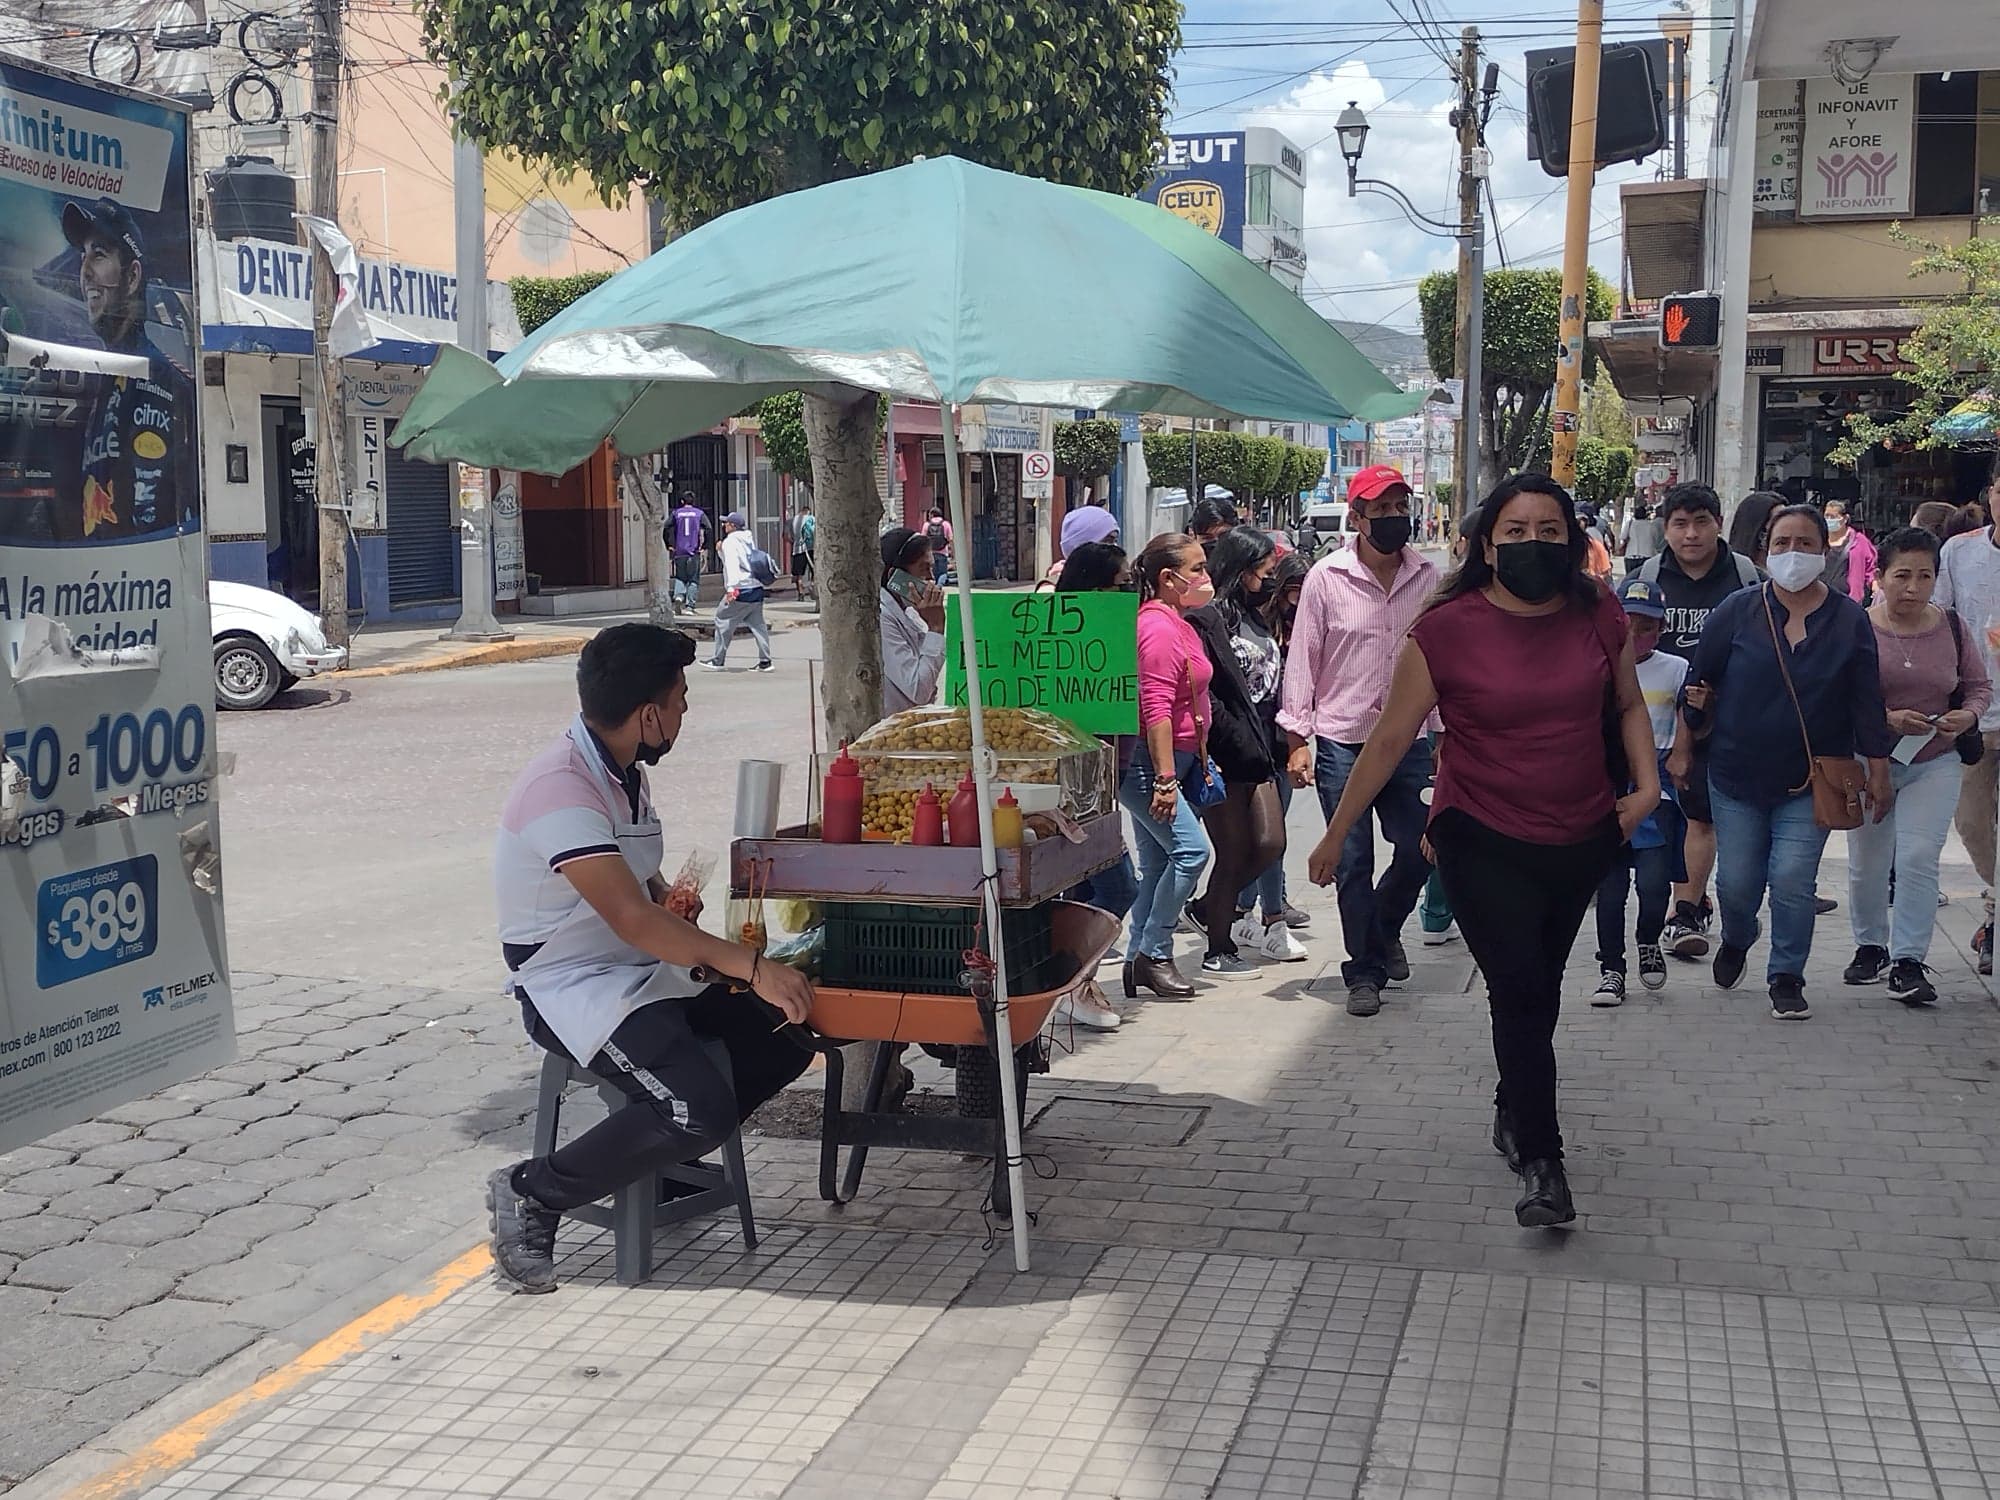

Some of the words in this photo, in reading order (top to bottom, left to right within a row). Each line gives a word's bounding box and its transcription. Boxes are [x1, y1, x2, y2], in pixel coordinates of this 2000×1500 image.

[1817, 98, 1899, 114] INFONAVIT
[1846, 117, 1857, 130] Y
[1828, 134, 1882, 149] AFORE
[42, 159, 57, 181] de
[61, 163, 124, 194] Velocidad
[1164, 190, 1217, 209] CEUT
[1816, 197, 1896, 209] INFONAVIT
[359, 381, 388, 395] DENTAL
[133, 404, 171, 432] citrix
[0, 577, 11, 620] A
[21, 576, 45, 619] la
[54, 571, 172, 617] máxima
[1011, 594, 1085, 638] $15
[1661, 607, 1714, 634] NIK
[1013, 639, 1107, 673] MEDIO
[1016, 674, 1049, 708] DE
[1055, 674, 1138, 704] NANCHE
[68, 752, 80, 776] a
[86, 703, 205, 791] 1000
[142, 780, 208, 815] Megas
[50, 876, 91, 898] Paquetes
[92, 868, 119, 886] desde
[47, 881, 146, 960] $389
[116, 945, 125, 959] al
[125, 942, 145, 955] mes
[166, 971, 216, 999] TELMEX
[23, 1031, 37, 1047] de
[38, 1015, 83, 1042] Atención
[84, 1003, 120, 1024] Telmex
[53, 1037, 73, 1059] 800
[76, 1030, 94, 1050] 123
[96, 1021, 122, 1042] 2222
